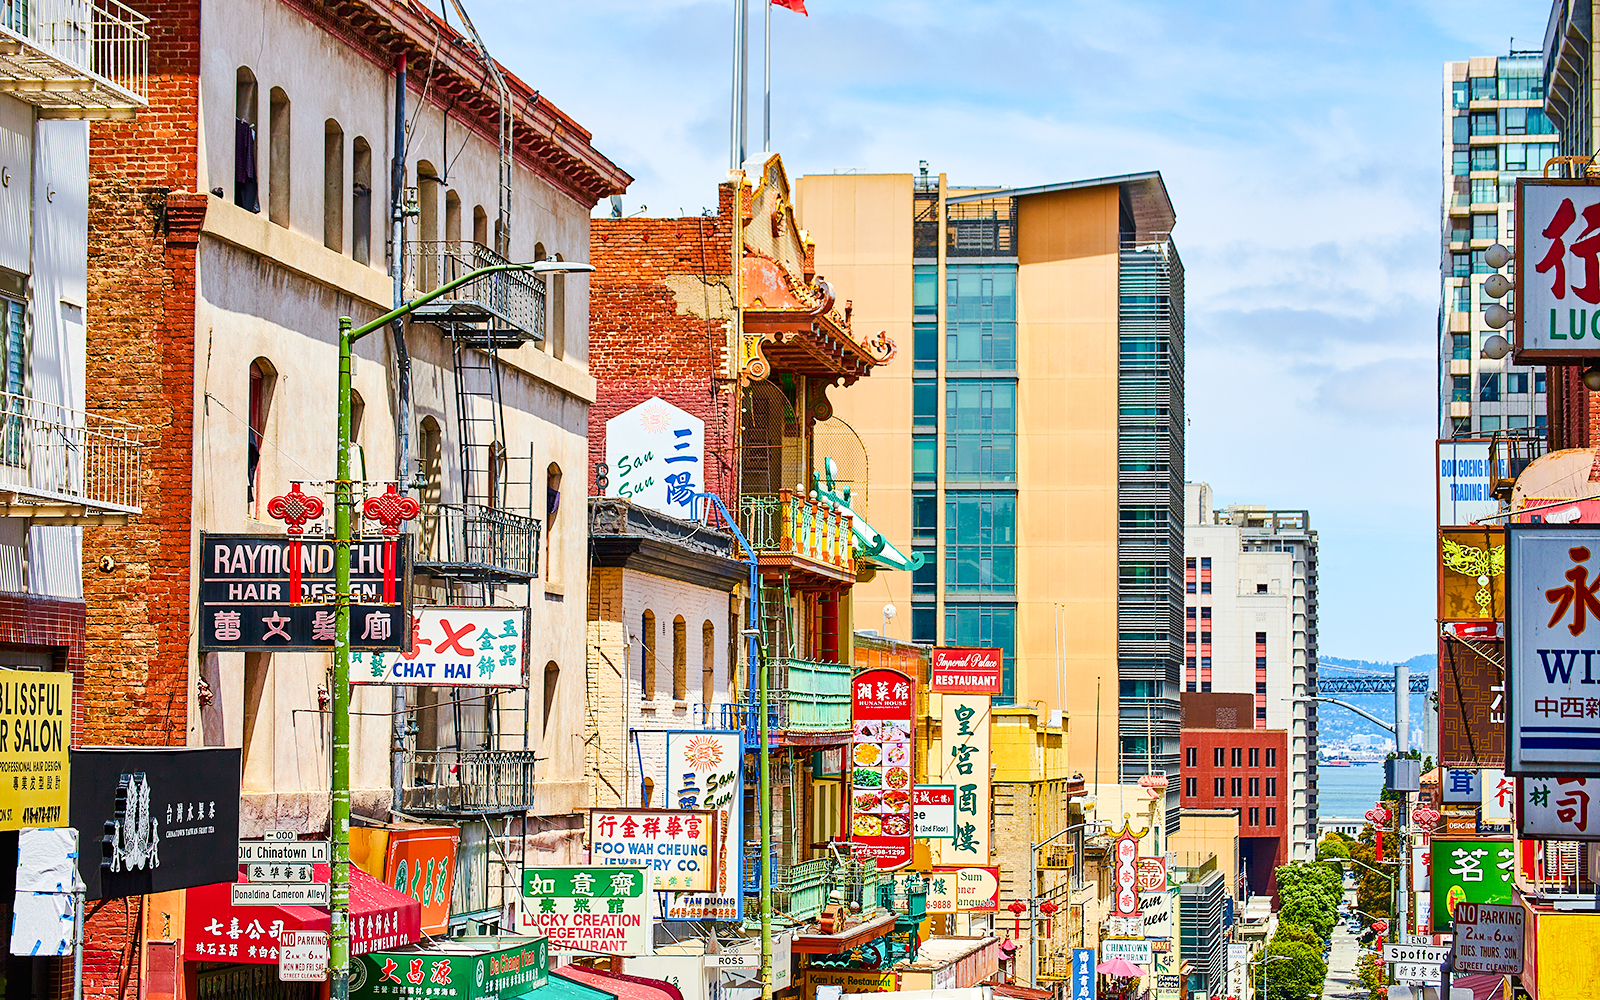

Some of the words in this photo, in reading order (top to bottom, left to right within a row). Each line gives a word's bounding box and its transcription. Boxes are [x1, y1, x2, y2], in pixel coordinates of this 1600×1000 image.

[617, 451, 654, 478] San
[664, 428, 699, 507] 三陽
[1458, 459, 1483, 477] COENG
[618, 476, 655, 498] Sun
[1449, 483, 1482, 501] TRADING
[228, 583, 282, 601] HAIR
[301, 583, 377, 600] DESGN
[935, 652, 971, 671] Imperial
[970, 653, 998, 668] Palace
[392, 662, 436, 678] CHAT
[444, 663, 472, 679] HAI
[935, 674, 997, 686] RESTAURANT
[14, 718, 62, 753] SALON
[33, 761, 44, 772] HAIR
[44, 760, 62, 772] DESIGN
[706, 771, 736, 794] San
[703, 792, 733, 809] Sun
[275, 831, 294, 840] 000
[256, 846, 308, 859] Chinatown
[311, 846, 324, 859] Ln
[594, 842, 625, 854] FOO
[627, 843, 654, 855] WAH
[657, 843, 709, 856] CHEUNG
[677, 859, 701, 872] CO.
[960, 871, 983, 881] Sum
[529, 871, 636, 897] 如意齋
[234, 889, 270, 900] Donaldina
[272, 889, 305, 900] Cameron
[306, 889, 327, 902] Alley
[683, 897, 702, 906] TAN
[704, 897, 736, 906] DUONG
[522, 913, 570, 927] LUCKY
[573, 913, 641, 927] CREATION
[1458, 904, 1476, 922] NO
[1479, 909, 1522, 926] PARKING
[282, 933, 296, 946] NO
[297, 935, 327, 946] PARKING
[538, 927, 626, 939] VEGETARIAN
[350, 940, 368, 956] JADE
[369, 935, 398, 952] JEWELRY
[399, 932, 411, 946] CO.
[547, 940, 628, 952] ESTAURANT
[1105, 943, 1149, 952] CHINATOWN
[1411, 936, 1428, 945] END
[1390, 947, 1449, 961] Spofford
[1460, 945, 1478, 957] TUES.
[1479, 945, 1502, 959] THURS.
[1503, 947, 1519, 960] SUN.
[283, 963, 295, 972] MON
[295, 963, 306, 972] WED
[306, 963, 315, 971] FRI
[315, 963, 325, 972] SAT
[489, 956, 499, 976] Da
[500, 953, 520, 974] Chang
[520, 948, 535, 967] Yuan
[718, 957, 744, 965] ROSS
[1459, 961, 1484, 970] STREET
[1485, 962, 1519, 972] CLEANING
[379, 957, 453, 985] 大昌源
[809, 975, 828, 984] Kam
[830, 975, 845, 985] Lok
[847, 975, 891, 987] Restaurant
